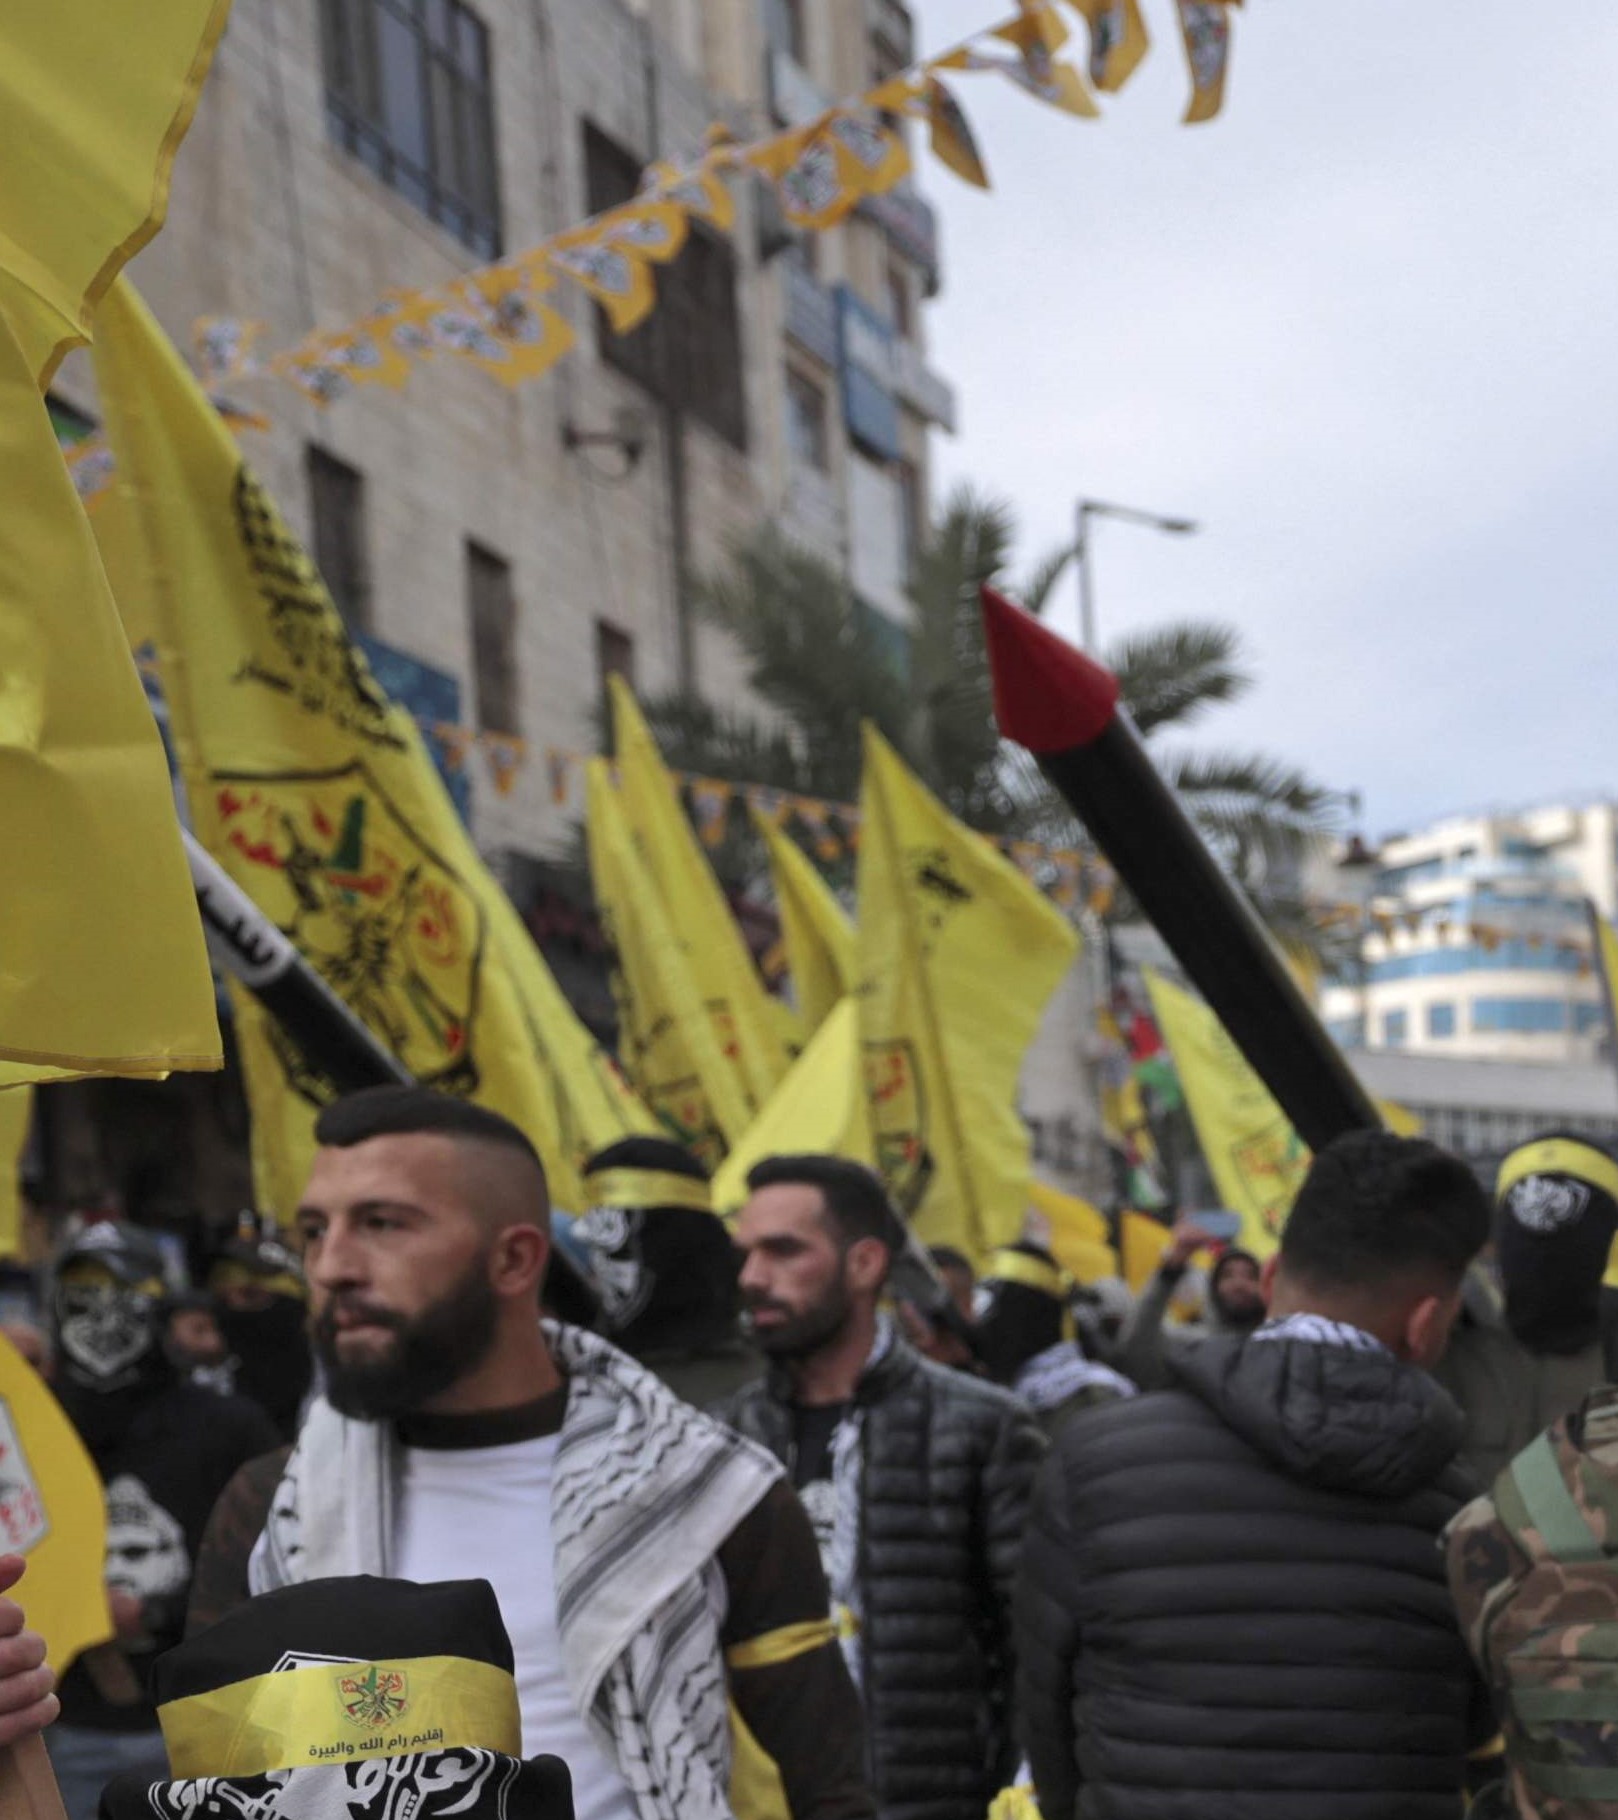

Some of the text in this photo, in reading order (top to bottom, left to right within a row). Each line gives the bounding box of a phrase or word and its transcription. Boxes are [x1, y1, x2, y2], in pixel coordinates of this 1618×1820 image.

[308, 1728, 444, 1758] إقليم رام الله والبيرة
